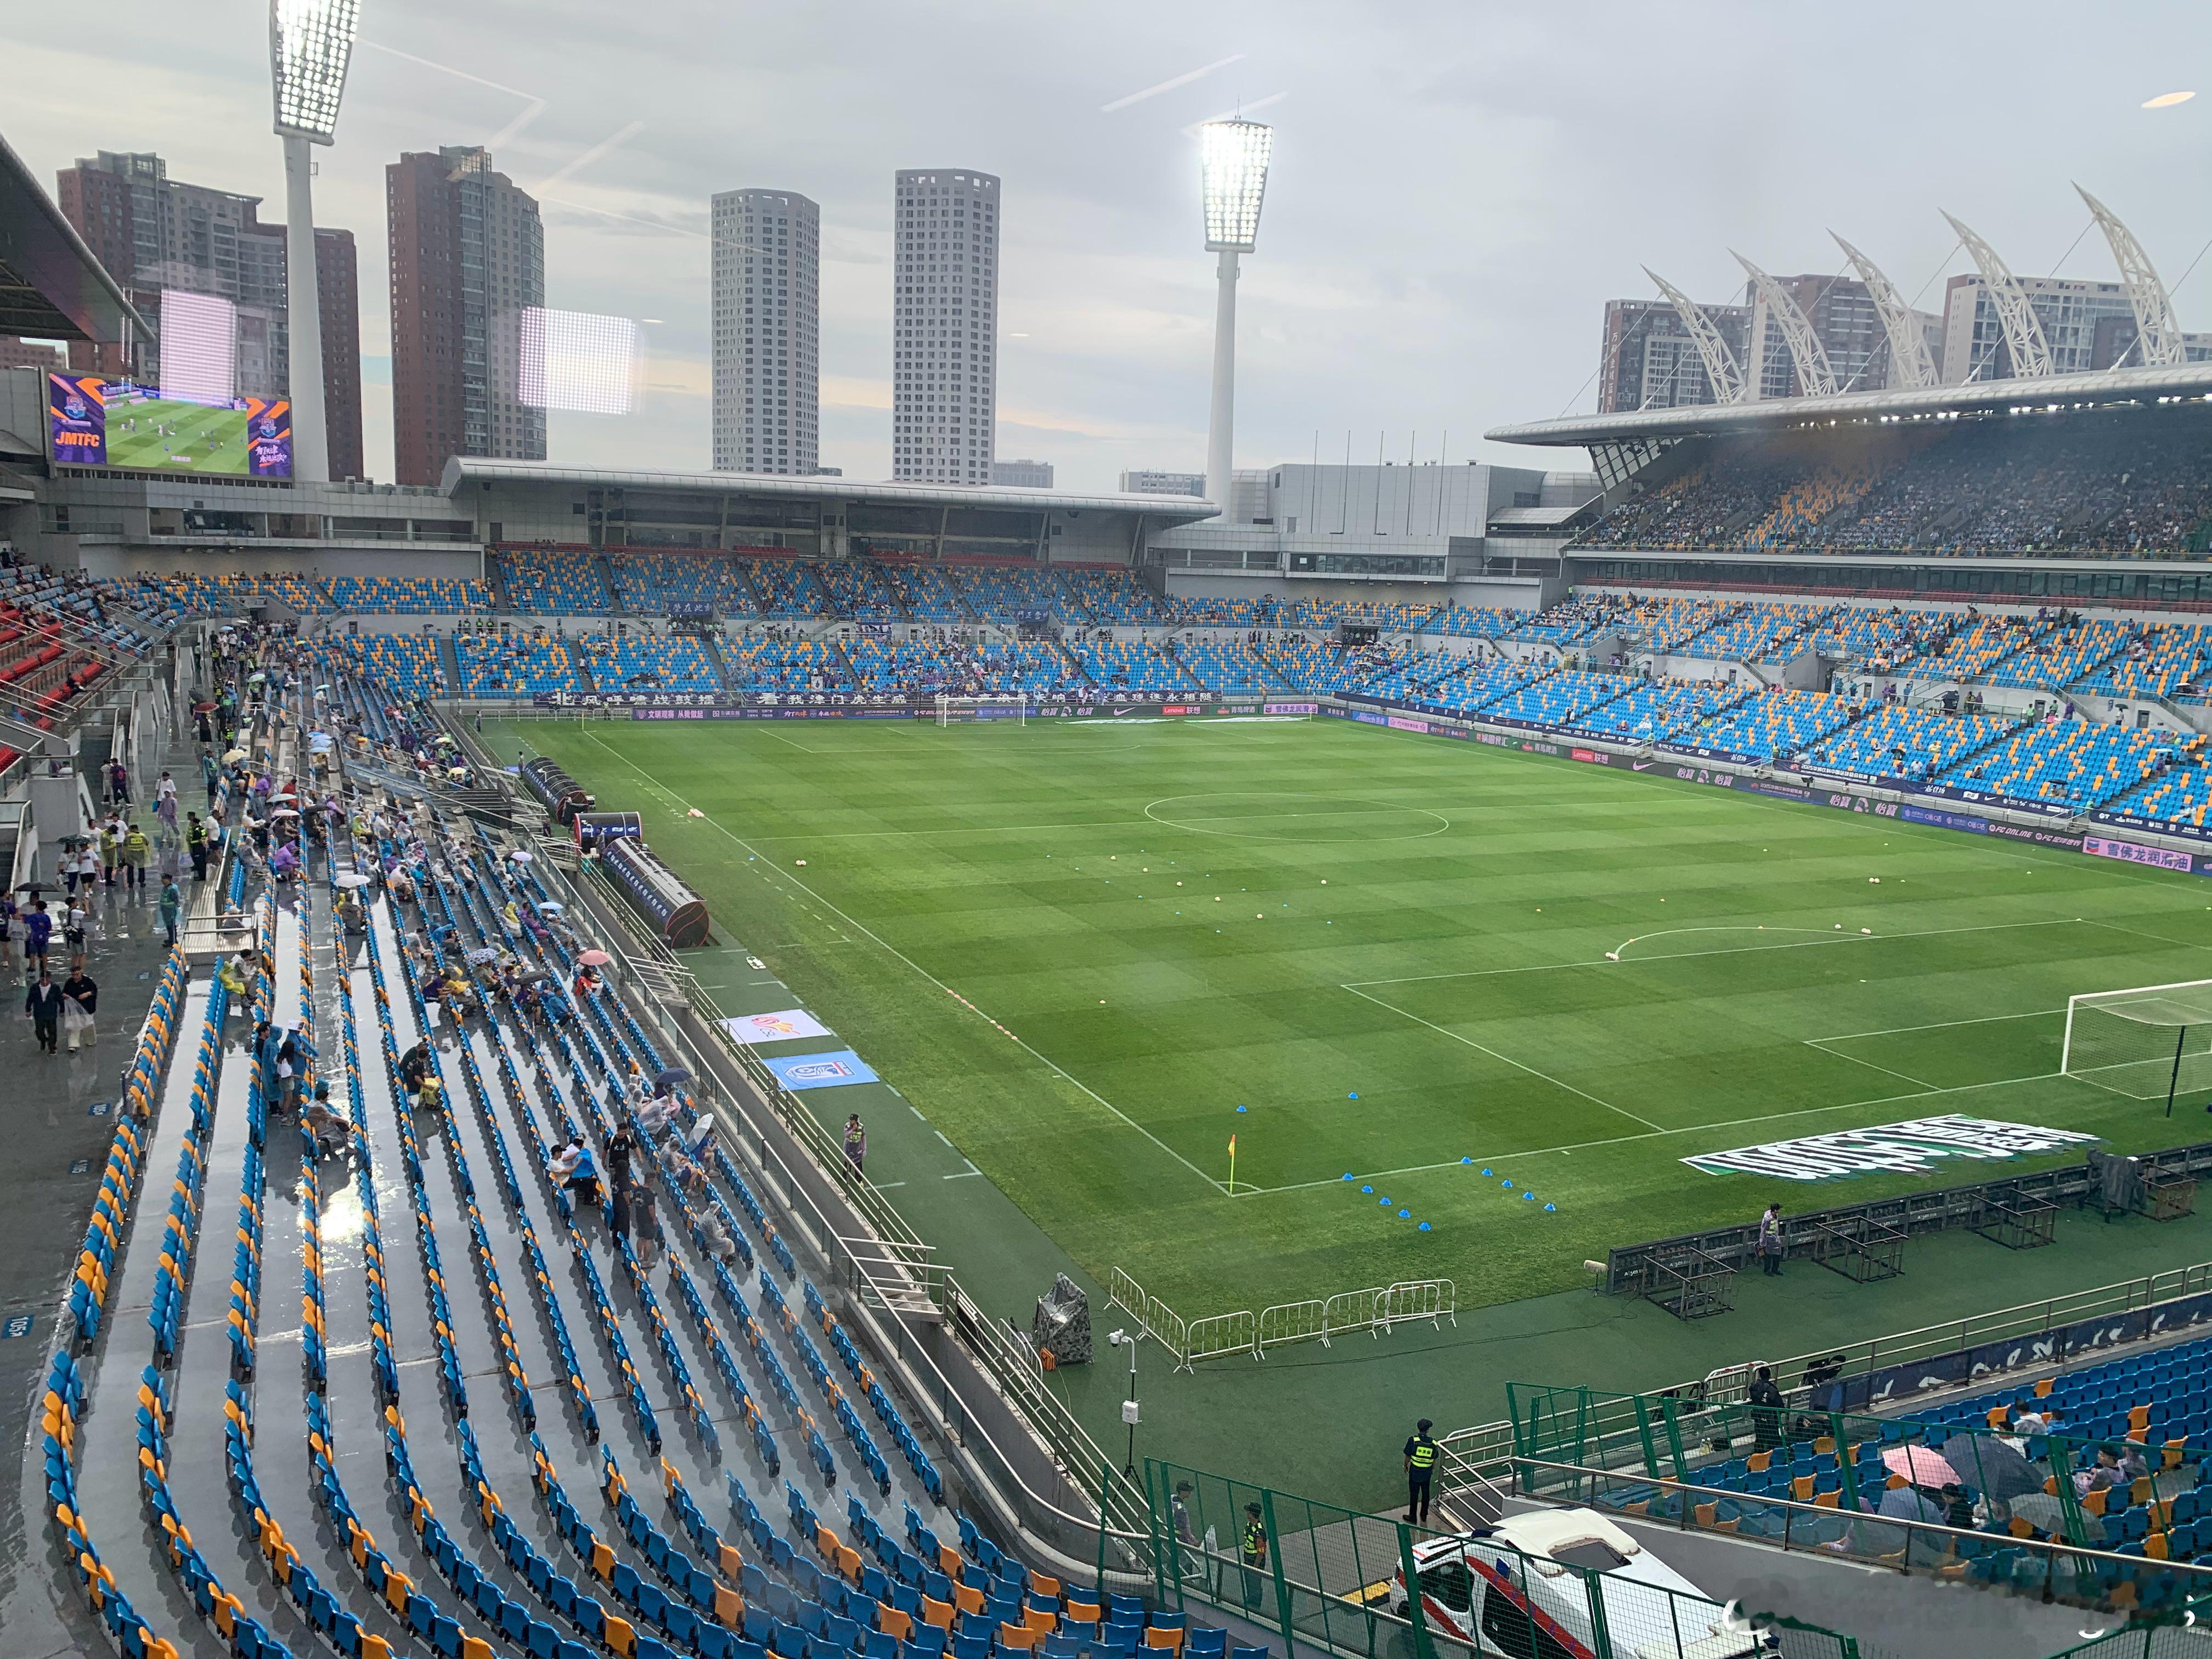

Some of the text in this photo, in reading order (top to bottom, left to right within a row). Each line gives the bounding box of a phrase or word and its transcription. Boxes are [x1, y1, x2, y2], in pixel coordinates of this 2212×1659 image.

[55, 432, 100, 447] JMTFC
[648, 710, 674, 719] 文明观赛
[1186, 706, 1200, 715] 联想
[1573, 751, 1609, 764] Lenovo 联想
[2005, 828, 2033, 838] ONLINE
[2042, 834, 2052, 842] FC
